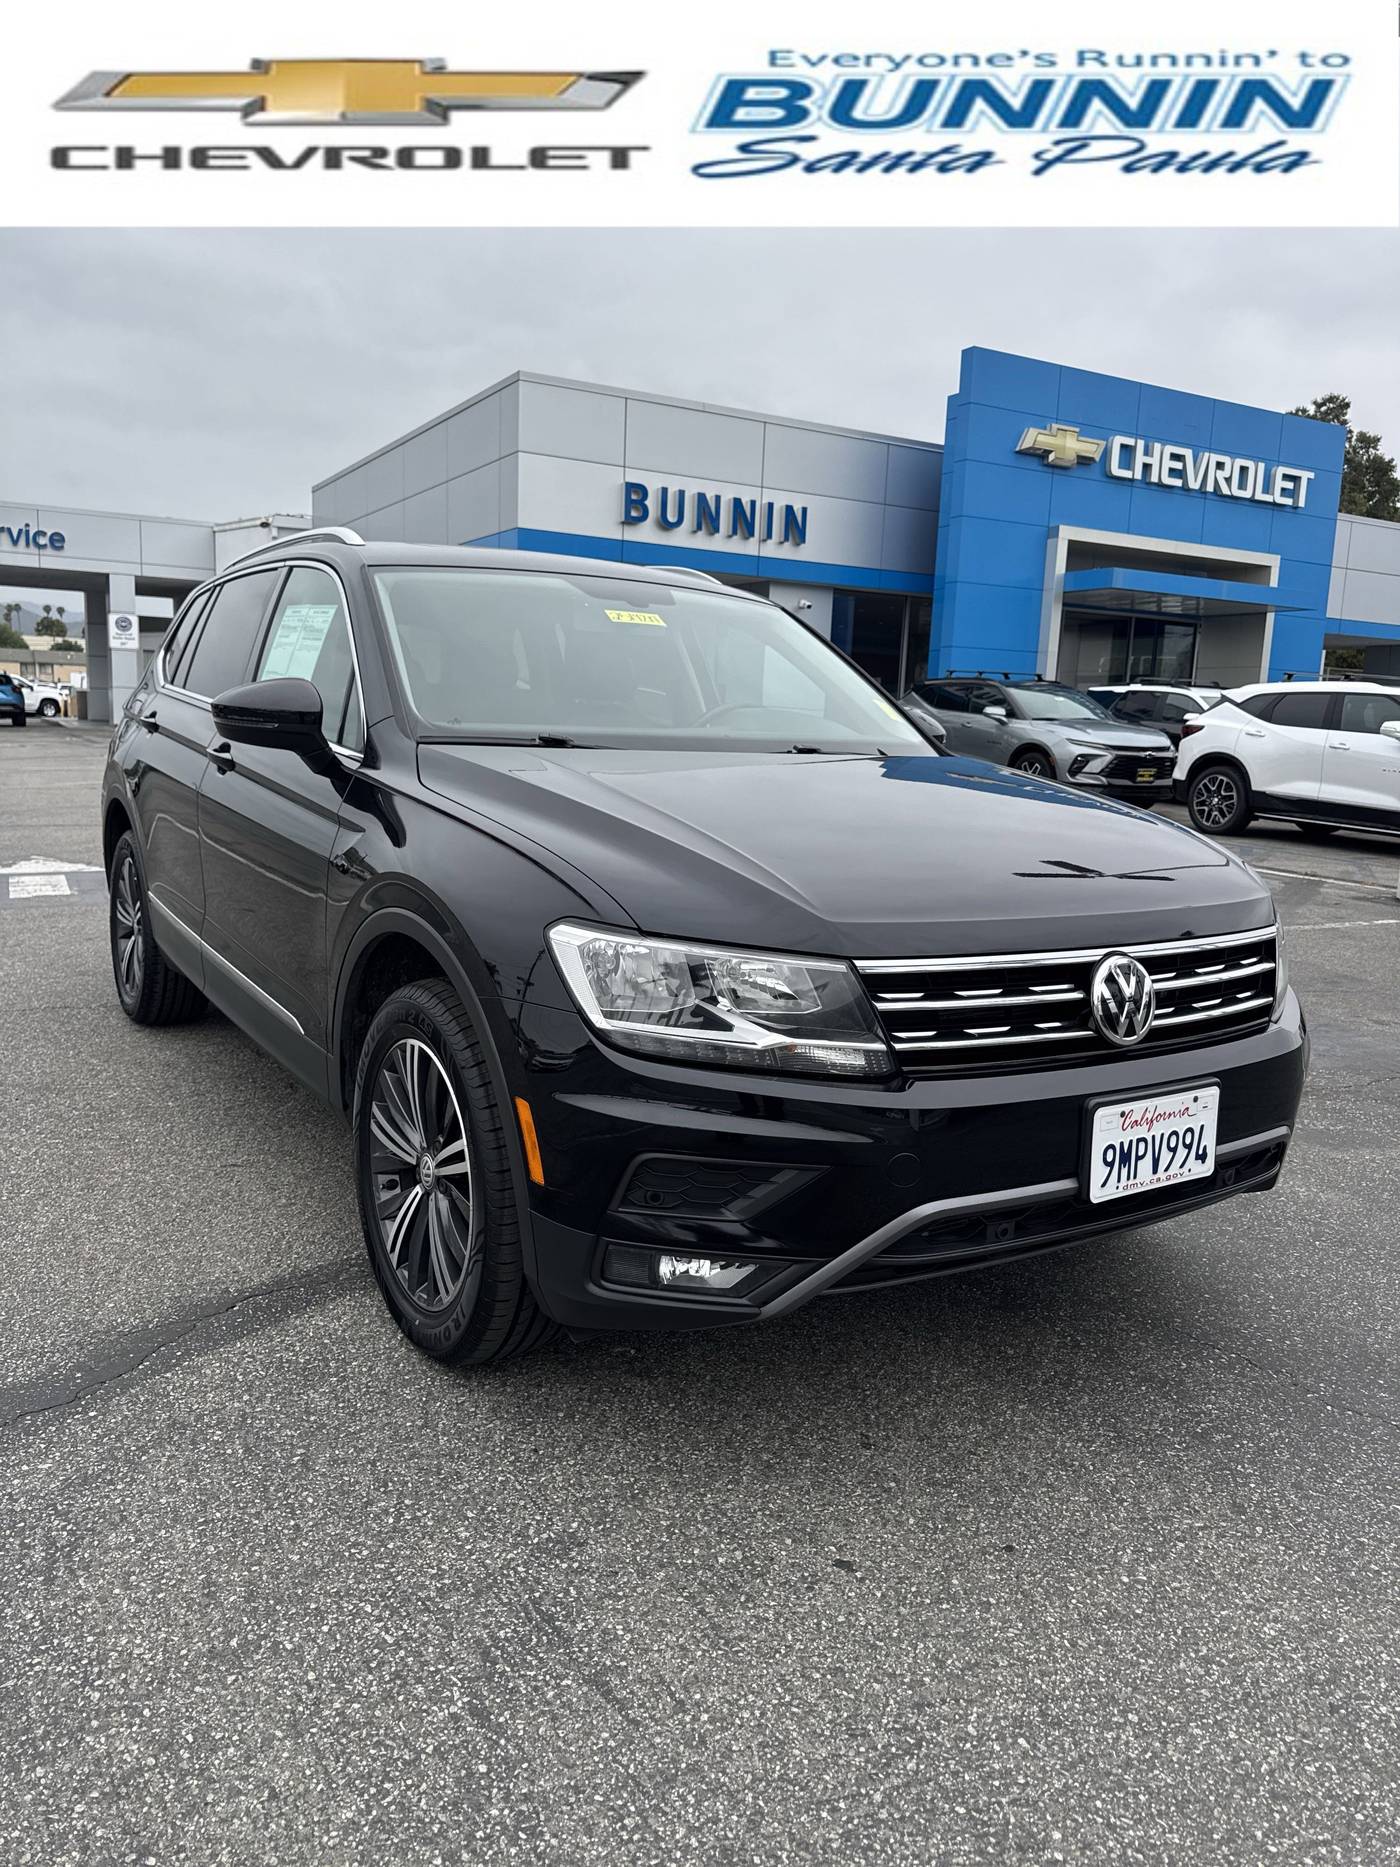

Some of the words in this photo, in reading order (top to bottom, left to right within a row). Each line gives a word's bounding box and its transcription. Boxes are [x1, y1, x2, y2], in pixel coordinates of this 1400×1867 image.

[1108, 435, 1316, 508] CHEVROLET
[621, 481, 808, 545] BUNNIN
[1120, 1101, 1198, 1133] California
[1100, 1123, 1209, 1189] 9MPV994
[1121, 1170, 1186, 1192] dmv.ca.gov
